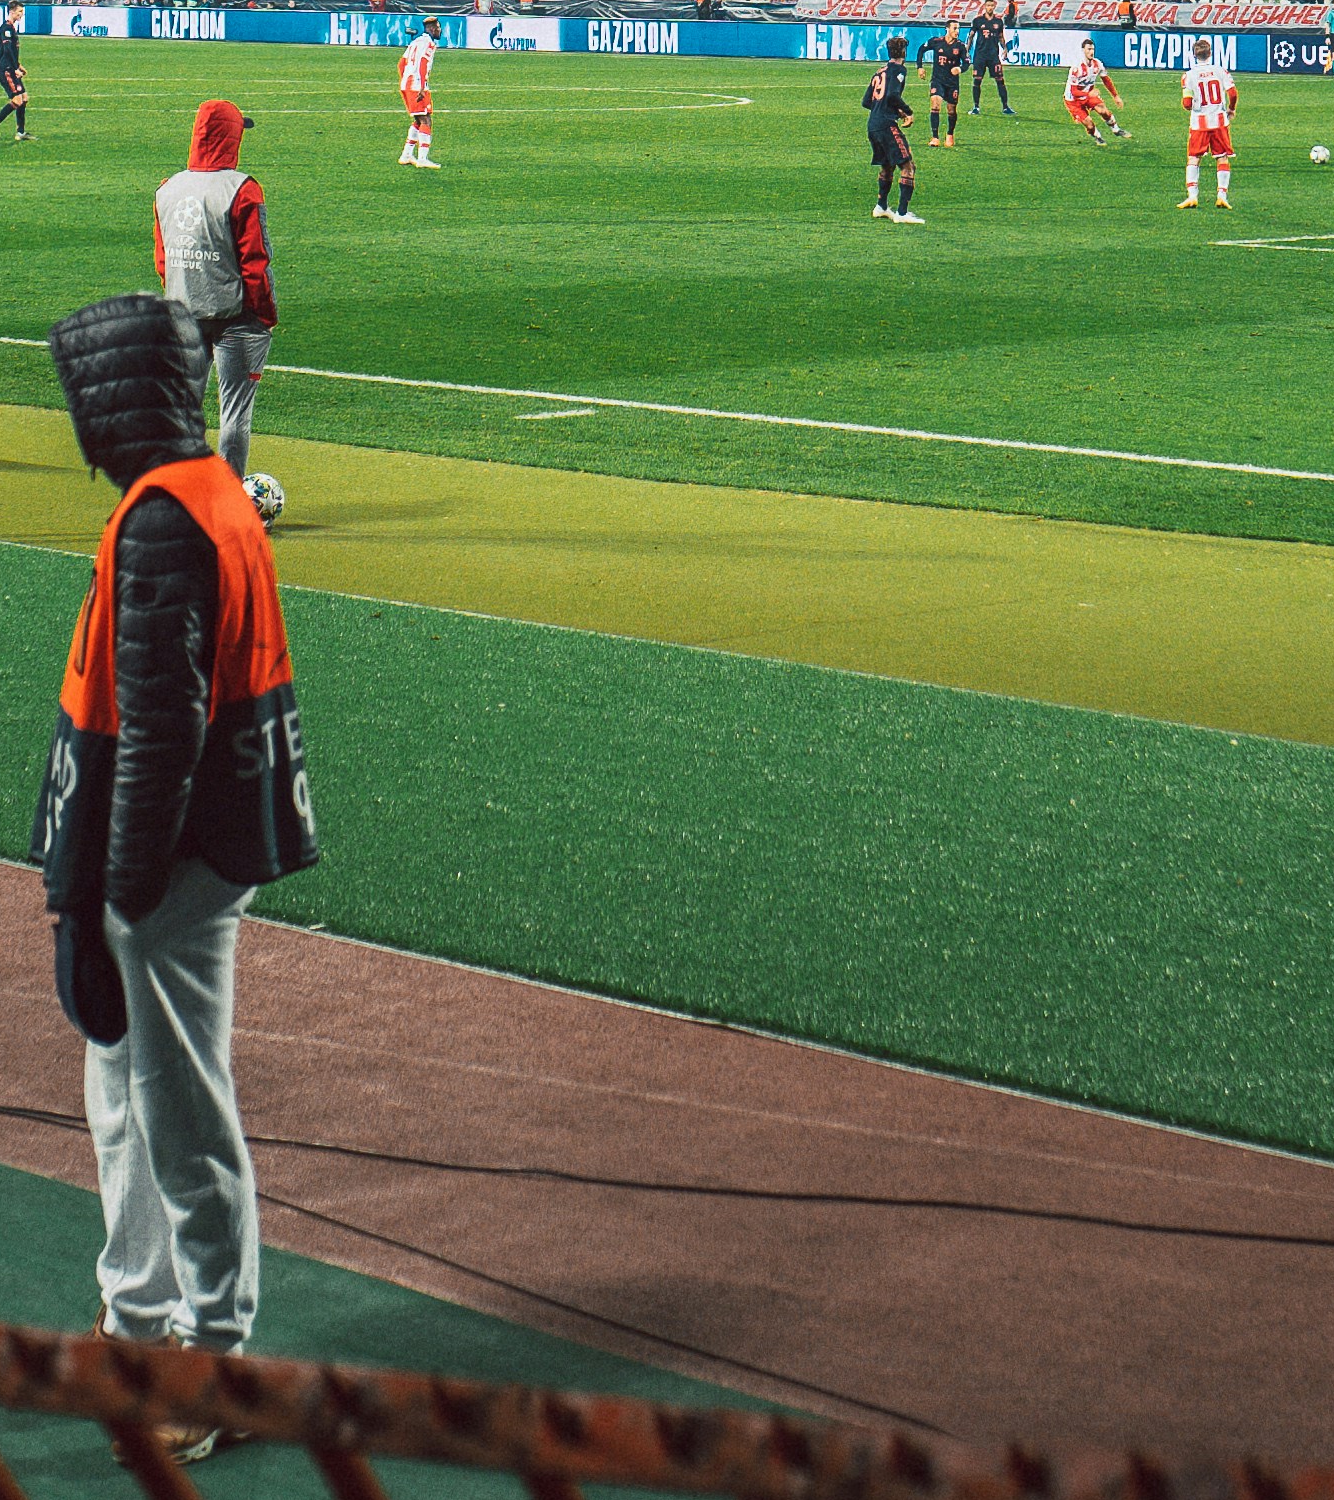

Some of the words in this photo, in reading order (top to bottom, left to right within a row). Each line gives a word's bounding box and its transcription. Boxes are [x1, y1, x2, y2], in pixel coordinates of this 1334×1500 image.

[151, 9, 226, 40] GAZPROM
[1033, 0, 1065, 20] СА
[1074, 1, 1179, 24] БРАИКА
[587, 21, 679, 54] GAZPROM
[1198, 79, 1222, 107] 10
